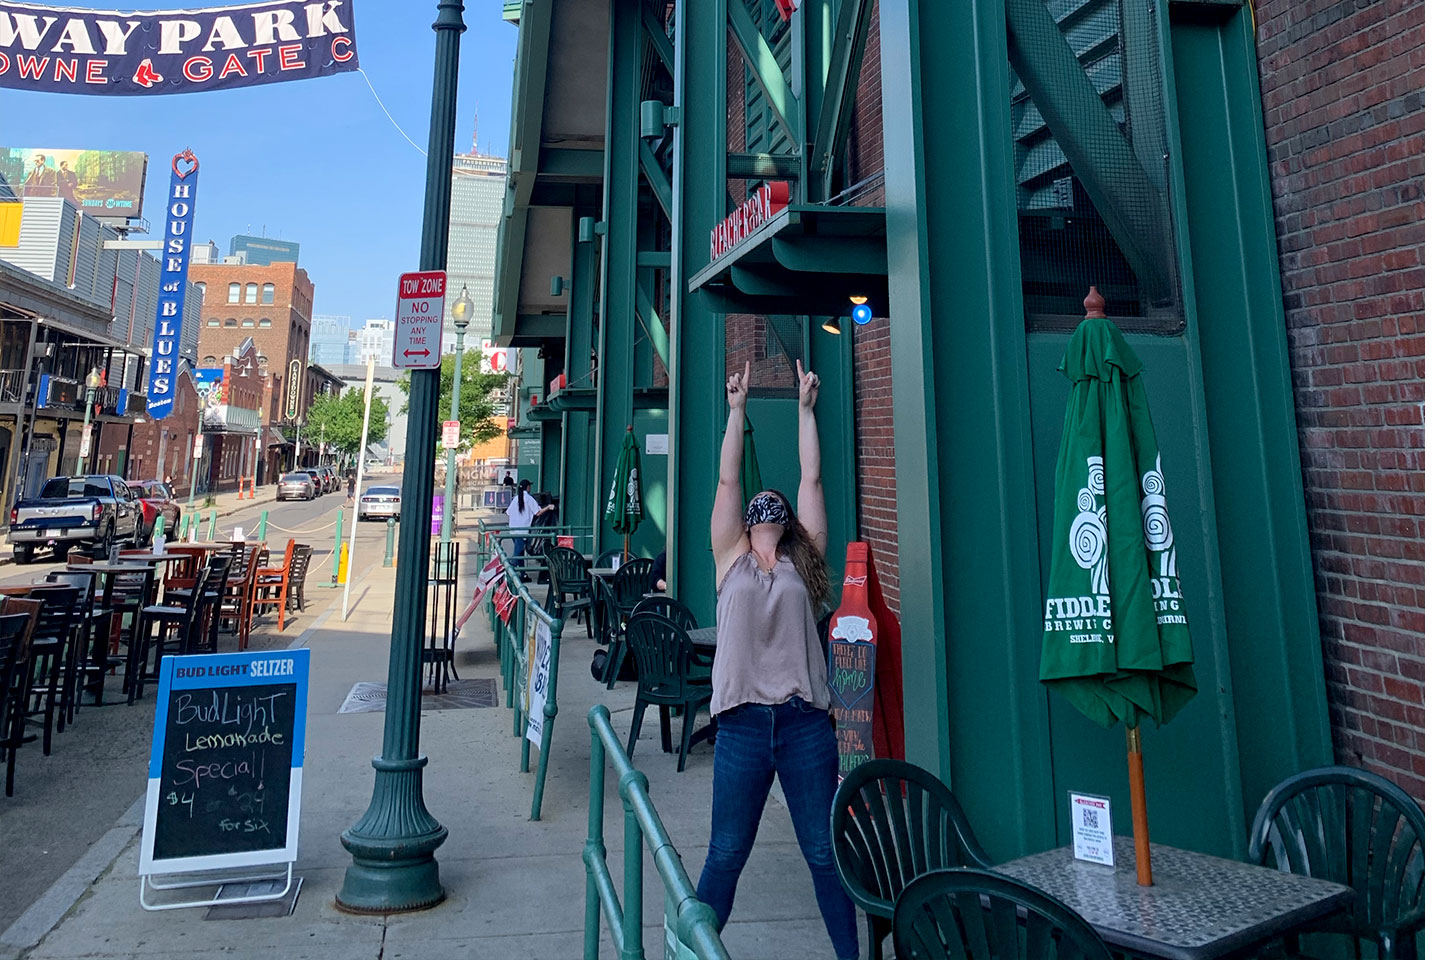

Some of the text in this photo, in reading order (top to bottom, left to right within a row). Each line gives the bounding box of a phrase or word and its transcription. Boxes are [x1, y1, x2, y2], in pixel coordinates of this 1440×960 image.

[157, 0, 349, 55] PARK
[182, 44, 306, 82] GATE
[331, 36, 354, 63] C
[153, 184, 190, 394] HOUSE of BLUES
[403, 278, 443, 294] TOW ZONE
[411, 301, 429, 313] NO
[400, 315, 438, 325] STOPPING
[409, 336, 427, 345] TIME
[410, 326, 427, 335] ANY
[176, 659, 294, 679] BUD LIGHT SELTZER
[832, 667, 866, 695] home
[185, 725, 284, 752] Lemonade
